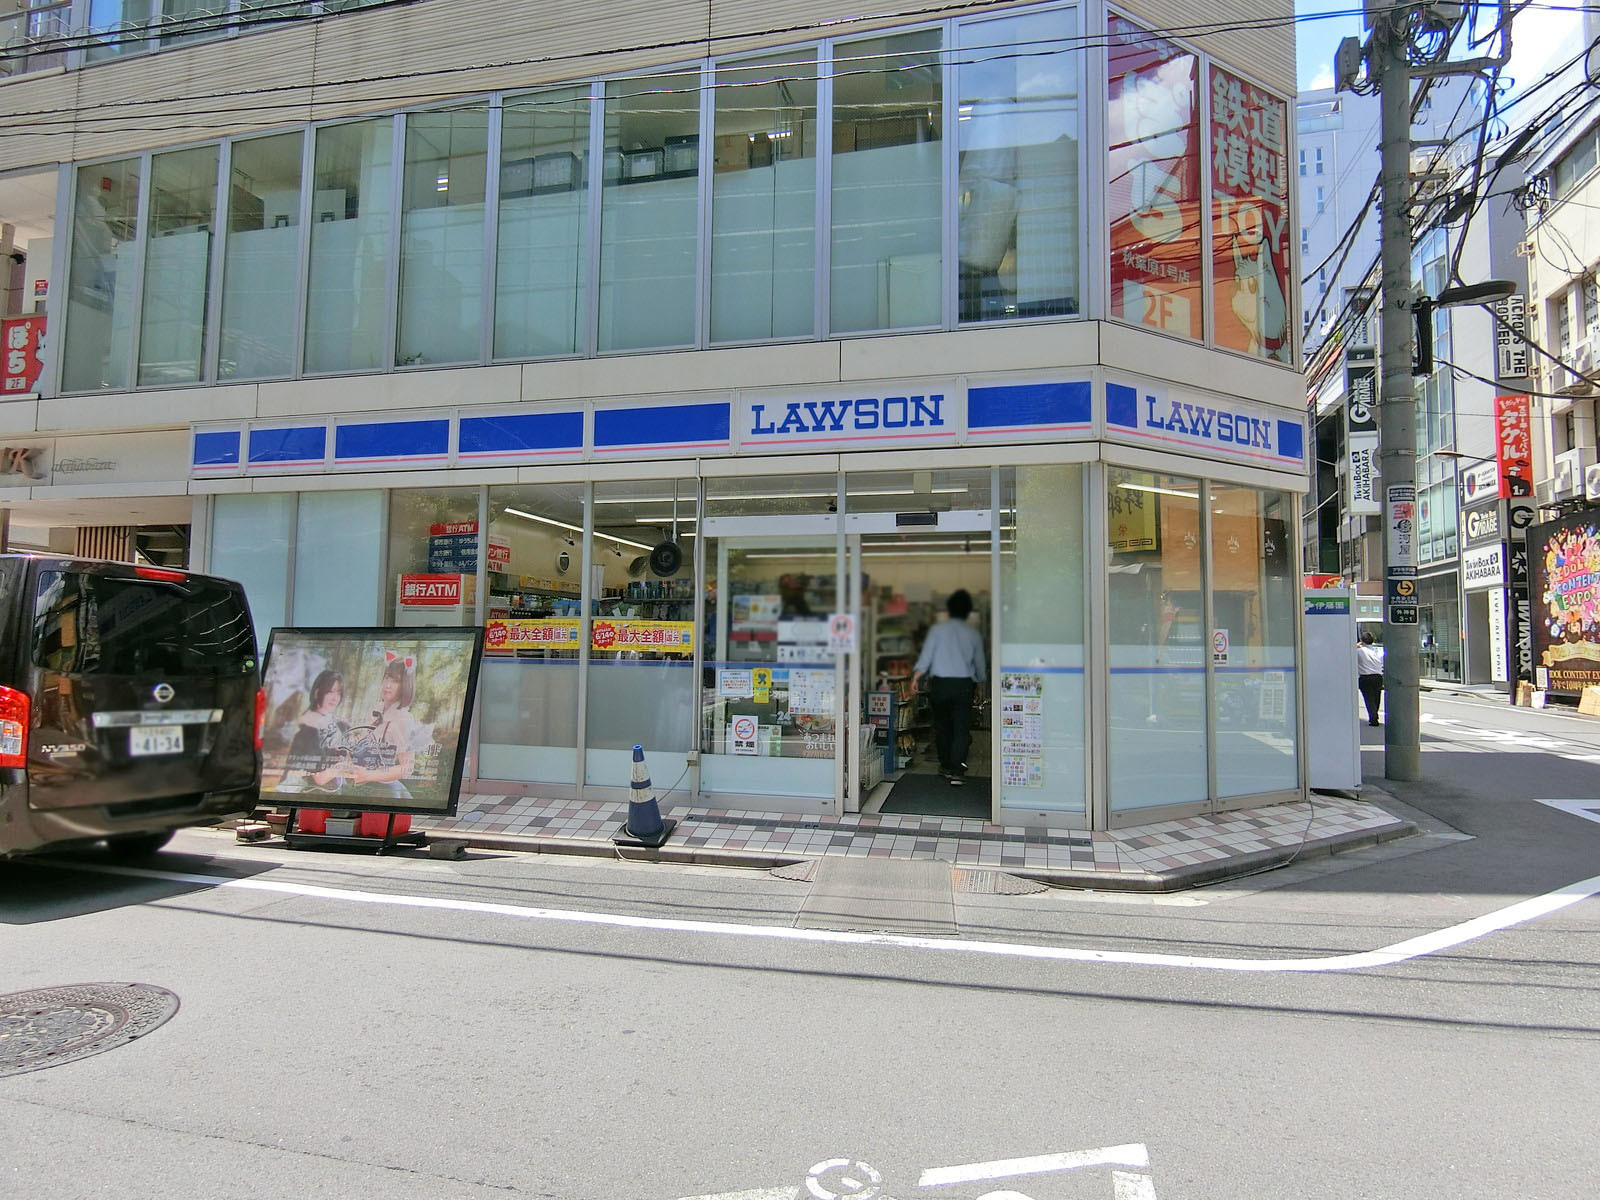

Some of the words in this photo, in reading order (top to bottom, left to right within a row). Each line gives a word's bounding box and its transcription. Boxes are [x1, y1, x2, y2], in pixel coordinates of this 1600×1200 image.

[1213, 71, 1282, 155] 鉄道
[1213, 127, 1282, 206] 模型
[1213, 188, 1288, 253] TOY
[1122, 249, 1190, 285] 秋葉原1号店
[1142, 290, 1173, 328] 2F
[8, 321, 31, 374] ぽち
[1513, 350, 1526, 374] THE
[11, 379, 21, 388] 2F
[751, 394, 944, 435] LAWSON
[1146, 395, 1272, 450] LAWSON
[1499, 410, 1521, 460] タケル
[1362, 448, 1370, 500] AKIHABARA
[1466, 566, 1501, 580] AKIHABARA
[1556, 559, 1584, 580] IDOL
[404, 584, 456, 596] 銀行ATM
[1561, 590, 1591, 610] EXPO
[510, 627, 554, 641] 最大全額
[617, 629, 664, 644] 最大全額
[1563, 670, 1591, 680] CONTENT
[41, 744, 86, 752] NV350
[143, 737, 180, 751] 41-34
